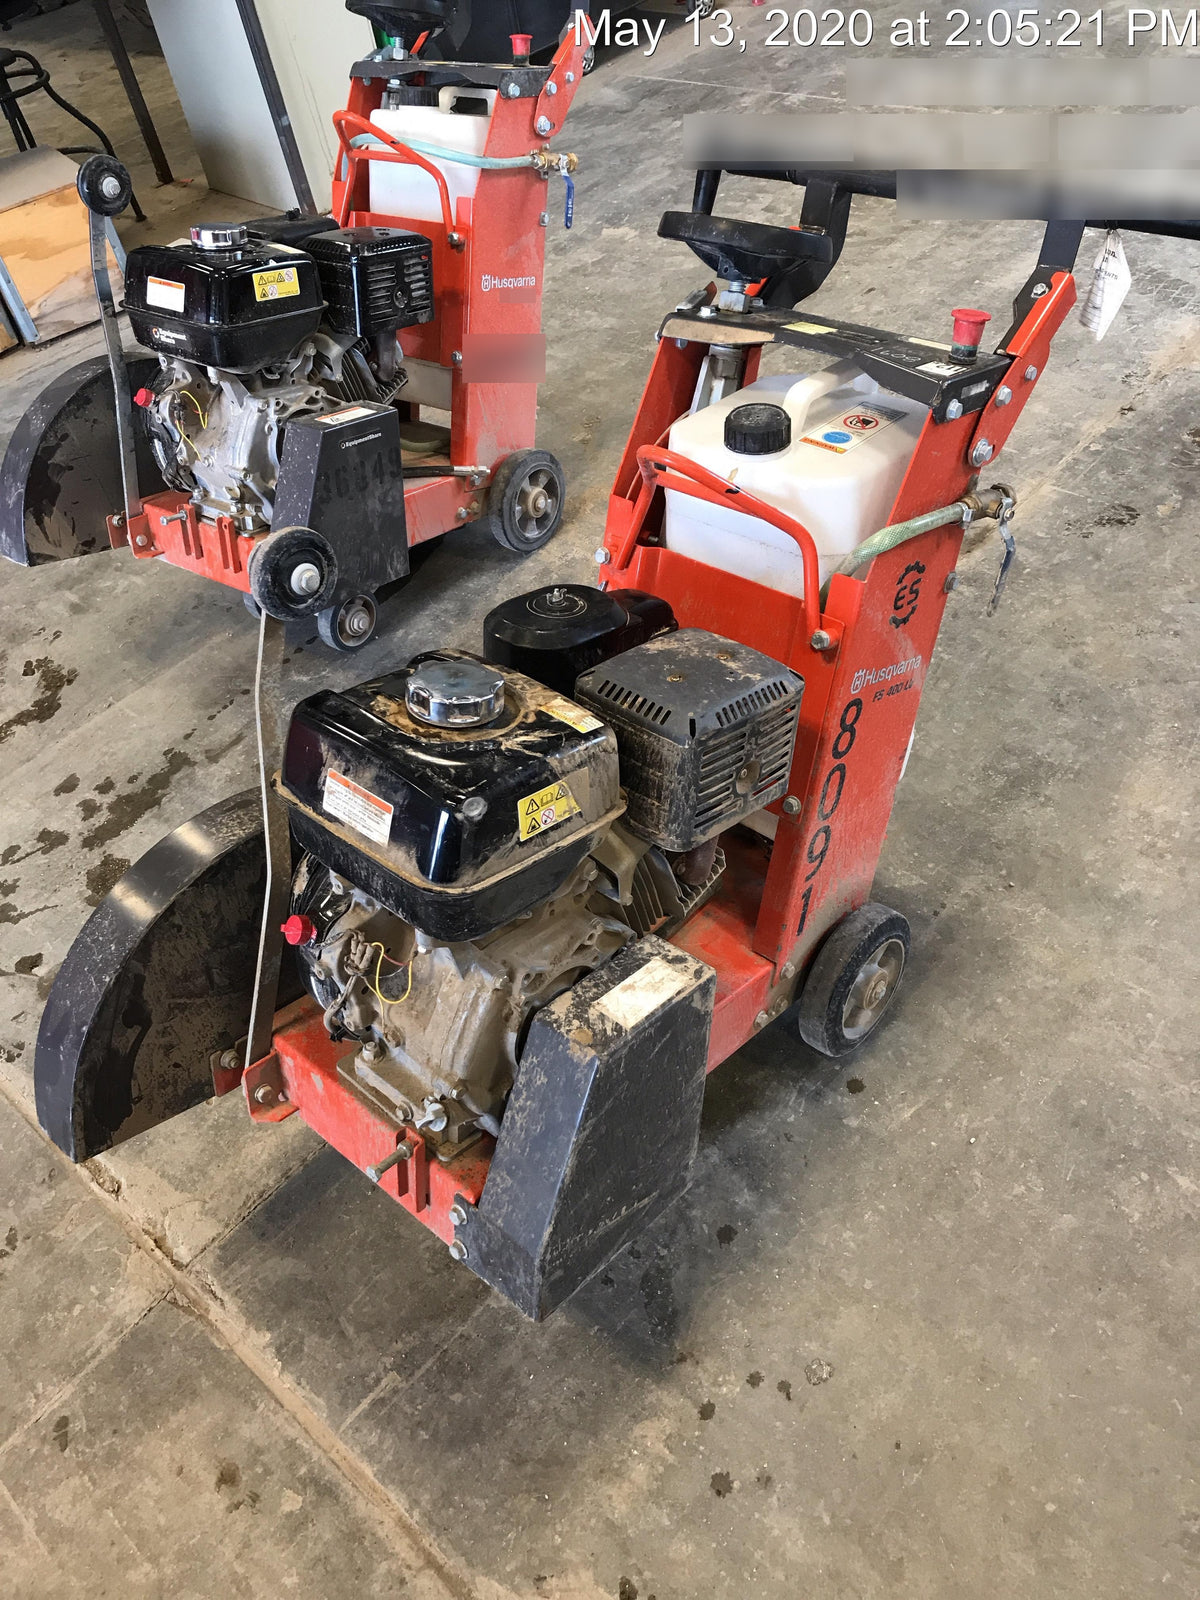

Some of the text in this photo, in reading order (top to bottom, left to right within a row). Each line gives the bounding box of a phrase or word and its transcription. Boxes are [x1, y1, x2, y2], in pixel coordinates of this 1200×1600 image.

[491, 275, 536, 289] Husqvarna
[893, 576, 923, 611] ES
[863, 654, 922, 689] Husqvarna
[872, 688, 885, 703] FS
[886, 681, 904, 697] 400
[796, 696, 863, 937] 8091
